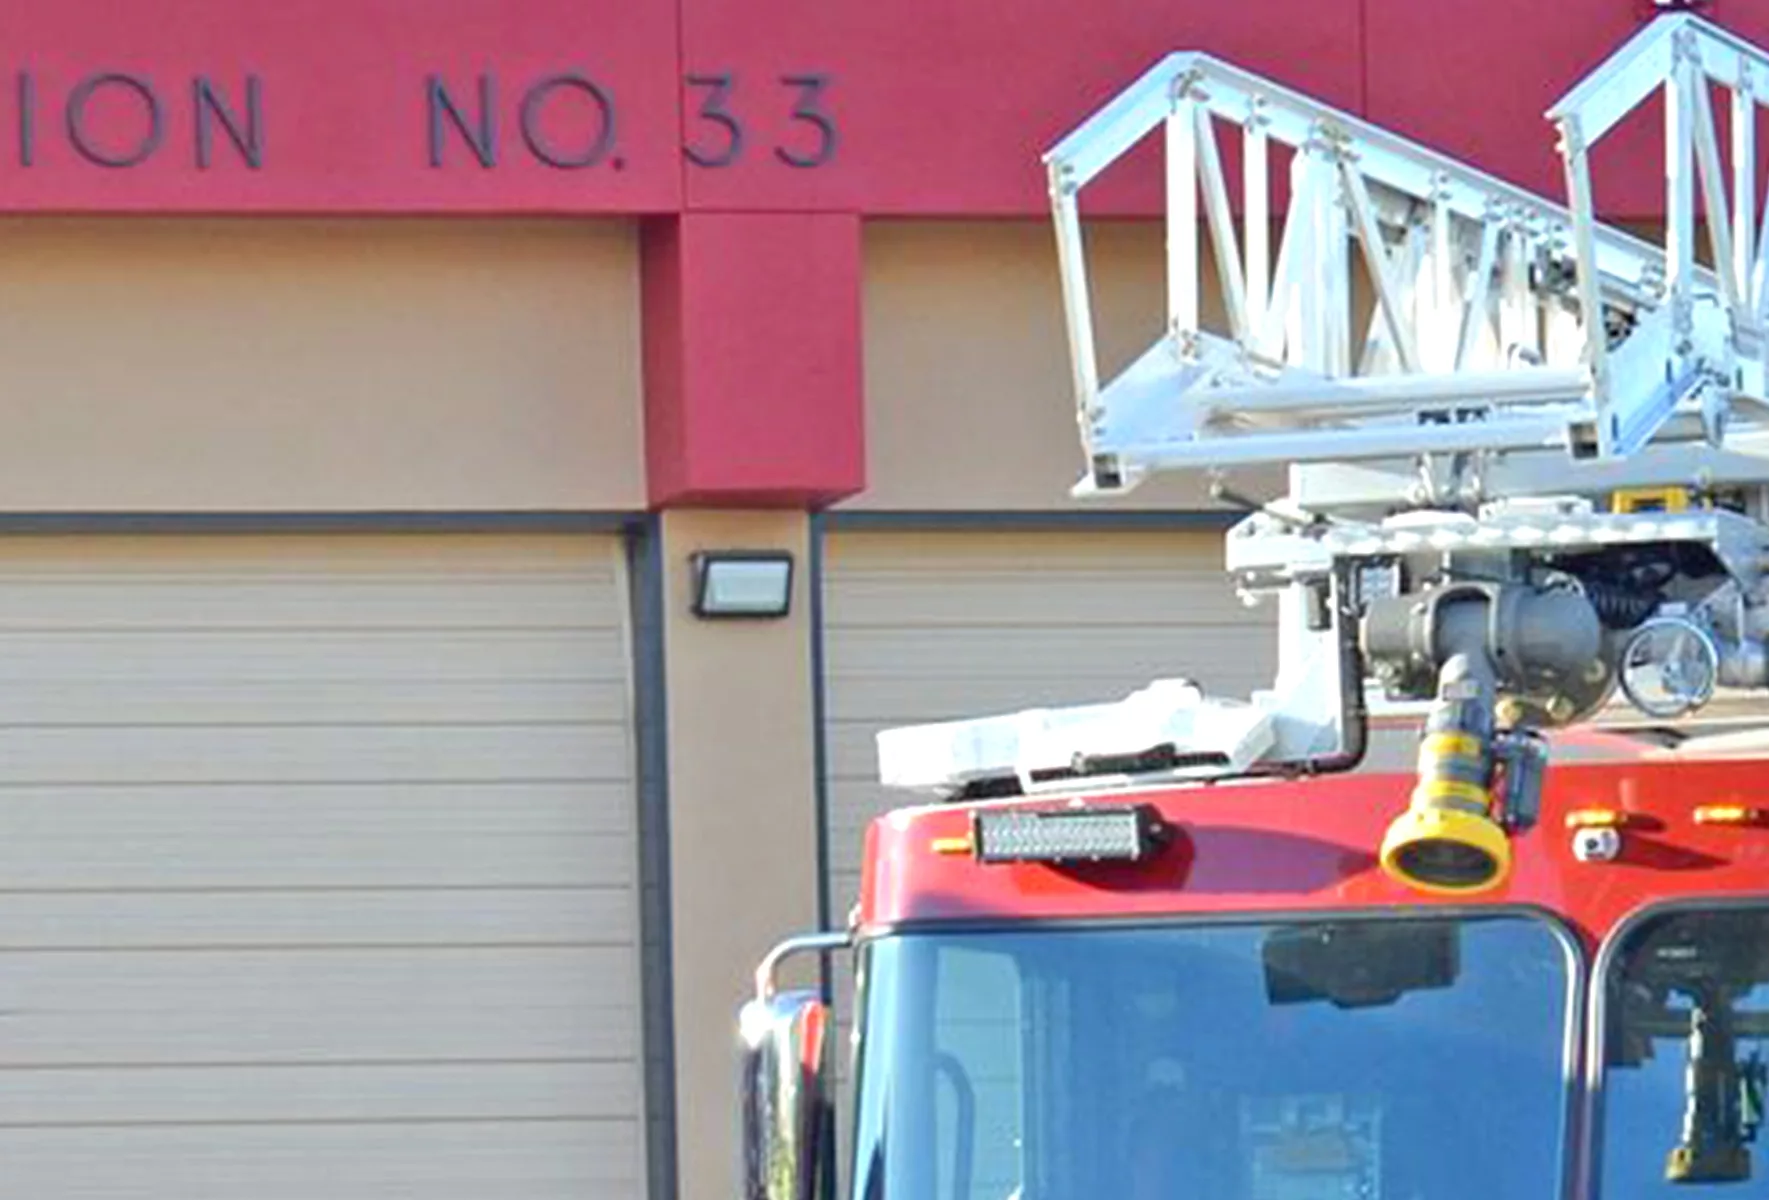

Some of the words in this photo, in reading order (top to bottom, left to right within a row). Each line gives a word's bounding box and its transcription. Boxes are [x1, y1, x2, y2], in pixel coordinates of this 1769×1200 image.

[17, 73, 263, 169] ION
[427, 73, 625, 169] NO.
[682, 74, 835, 169] 33
